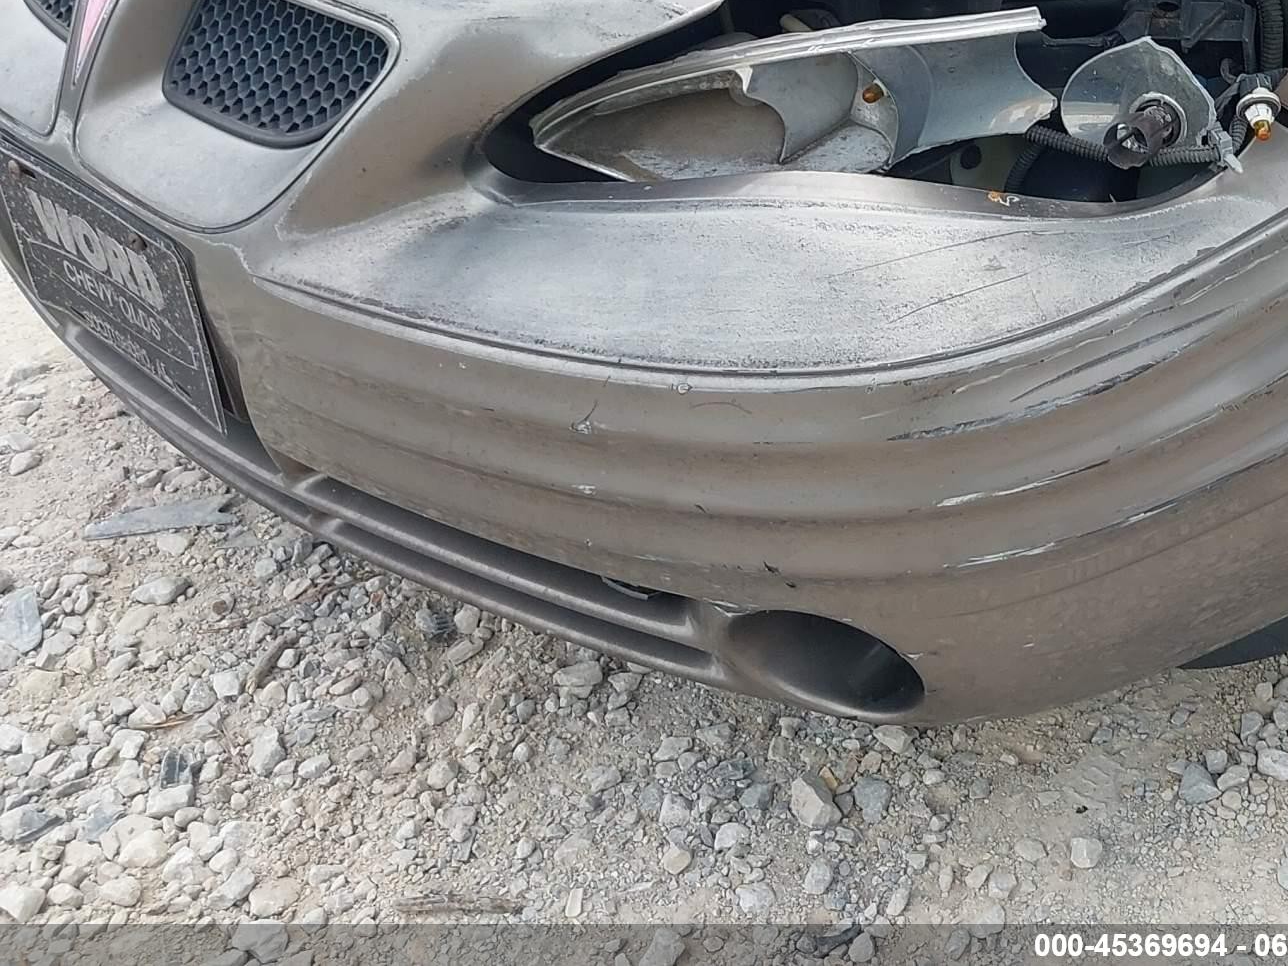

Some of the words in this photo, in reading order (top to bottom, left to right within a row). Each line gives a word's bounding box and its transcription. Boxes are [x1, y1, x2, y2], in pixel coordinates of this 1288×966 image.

[25, 186, 165, 312] WORD
[63, 260, 113, 307] CHEVY
[119, 296, 161, 341] OLDS
